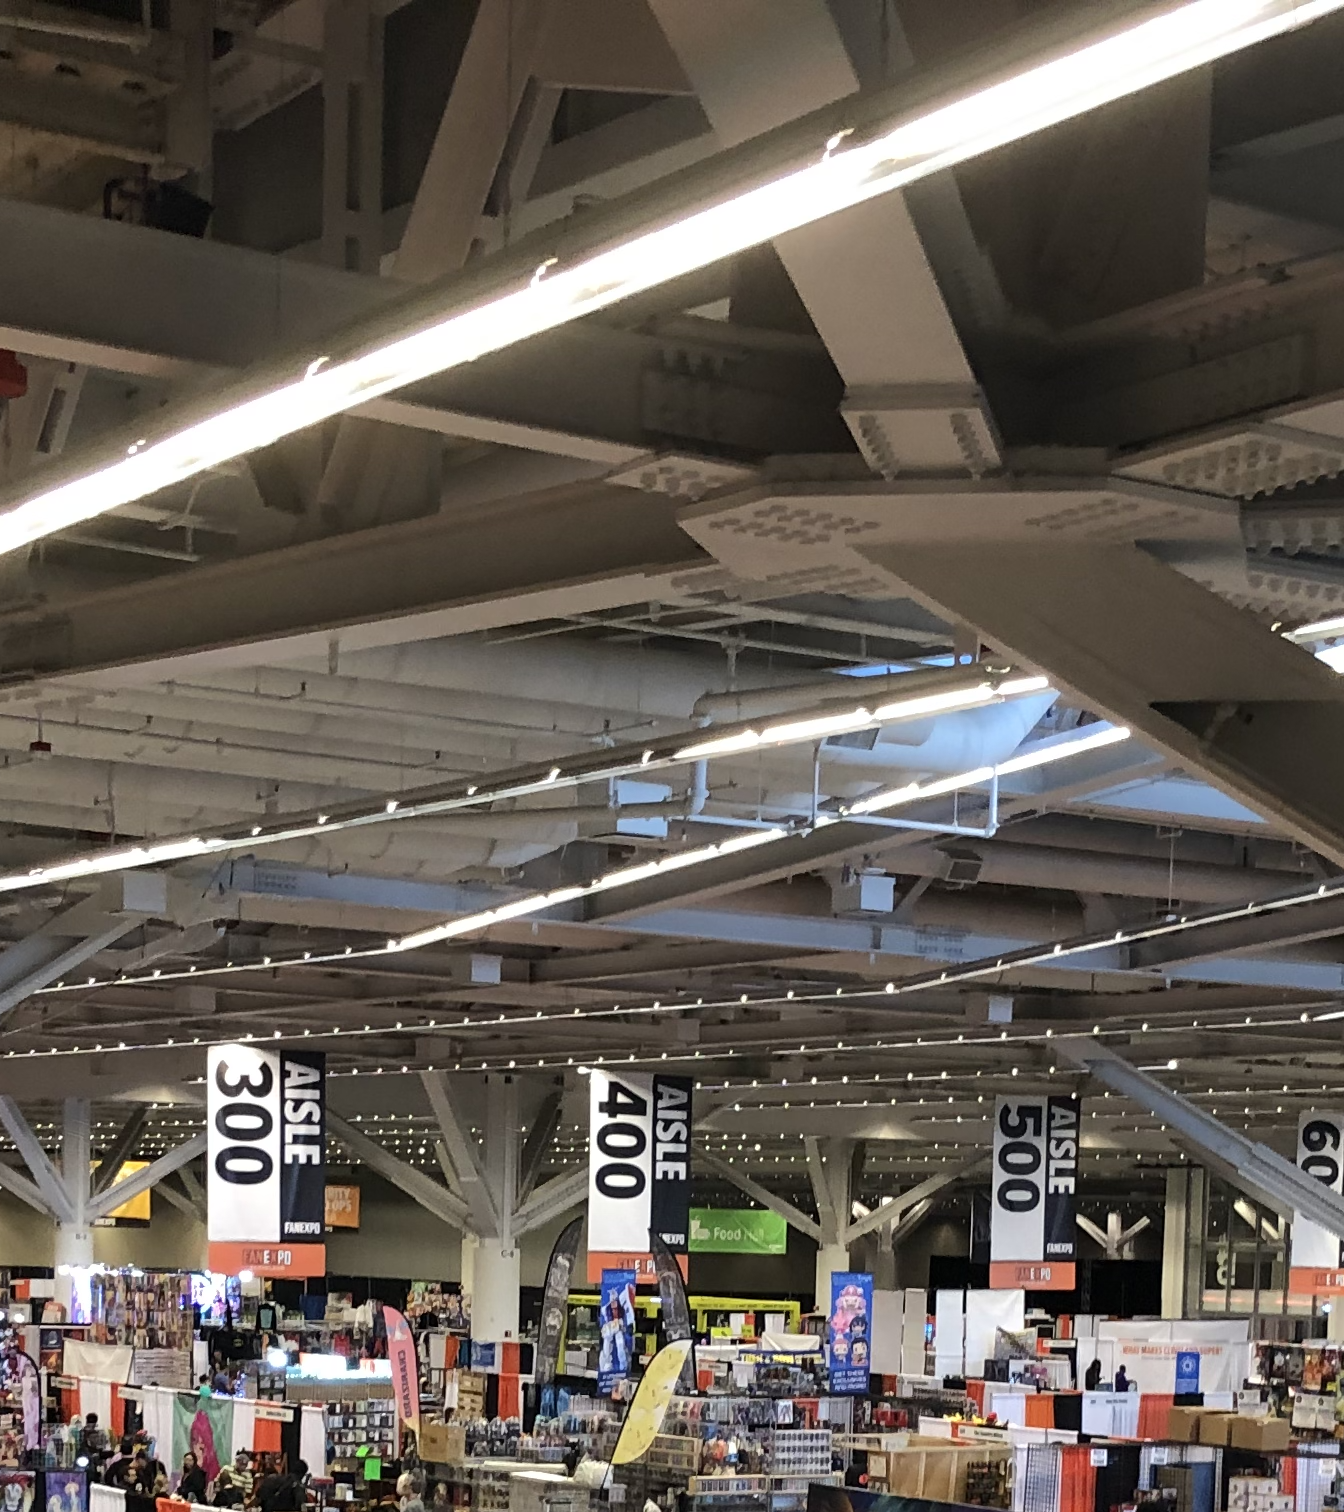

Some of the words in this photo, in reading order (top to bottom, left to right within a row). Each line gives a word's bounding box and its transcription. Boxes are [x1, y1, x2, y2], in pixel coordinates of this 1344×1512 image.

[215, 1060, 273, 1185] 300
[284, 1061, 321, 1165] AISLE
[596, 1081, 647, 1199] 400
[656, 1084, 688, 1180] AISLE
[997, 1104, 1042, 1213] 500
[1048, 1106, 1076, 1194] AISLE
[1301, 1120, 1341, 1187] 60
[242, 1250, 292, 1266] FANEXPO
[284, 1221, 320, 1234] FANEXPO
[713, 1227, 741, 1241] Food
